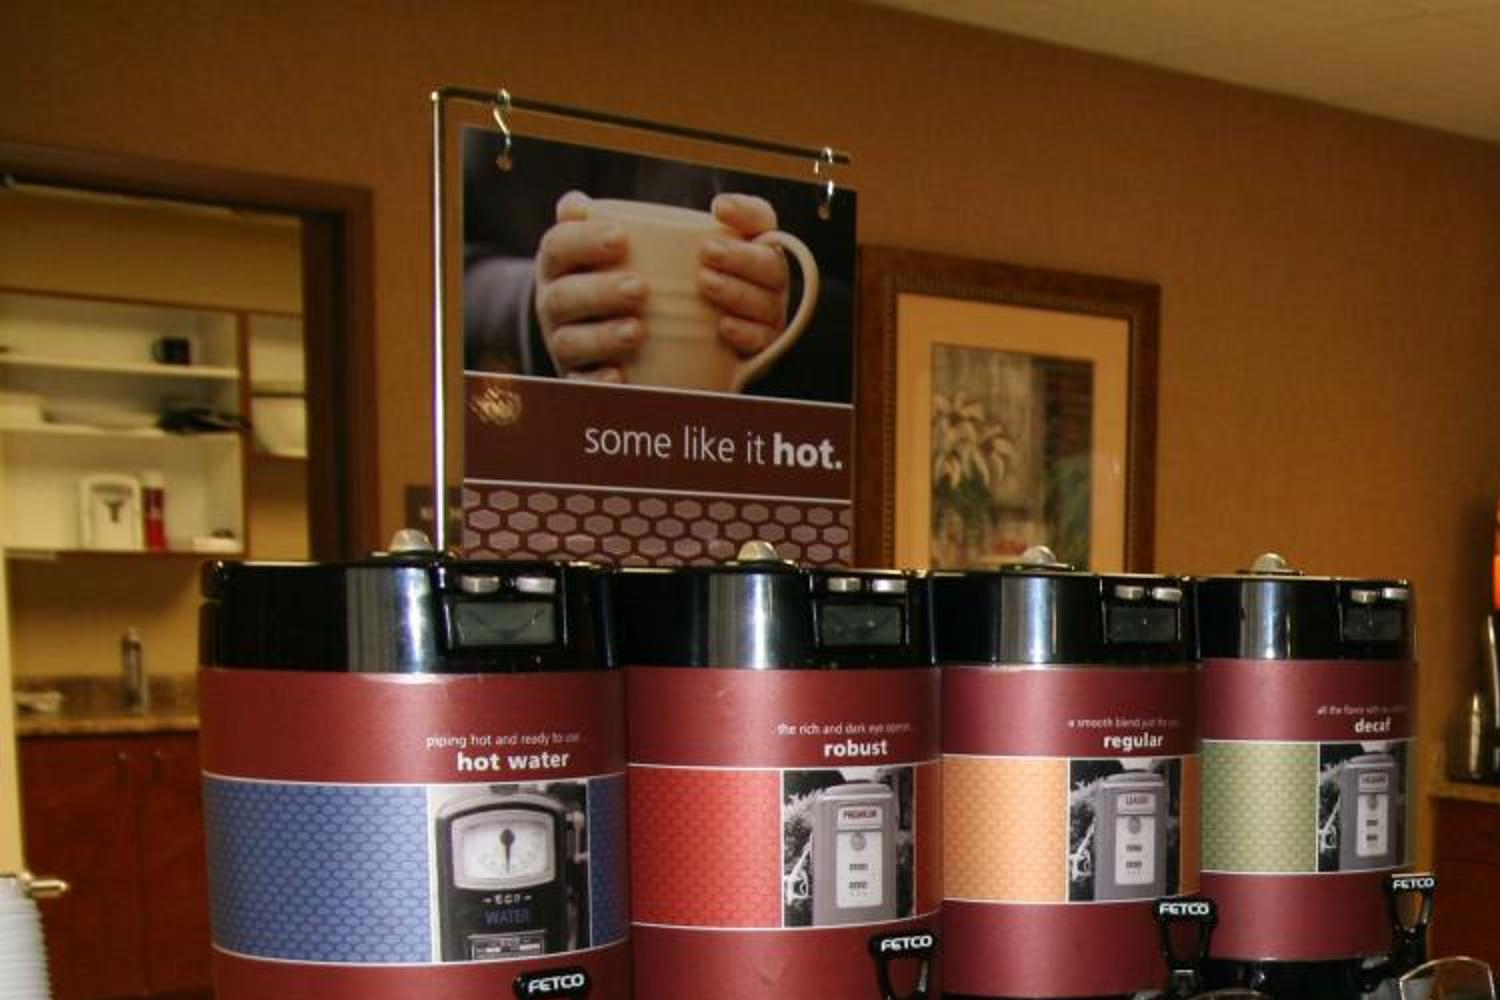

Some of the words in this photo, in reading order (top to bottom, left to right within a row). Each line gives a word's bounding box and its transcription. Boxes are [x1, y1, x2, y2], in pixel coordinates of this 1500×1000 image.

[584, 427, 672, 459] some
[683, 424, 736, 463] like
[747, 430, 766, 465] it
[773, 431, 844, 470] hot.
[778, 721, 797, 735] the
[799, 722, 820, 735] rich
[822, 722, 843, 735] and
[1077, 716, 1113, 728] smooth
[1355, 716, 1391, 733] decaf
[426, 733, 468, 748] piping
[470, 733, 493, 747] hot
[495, 733, 519, 746] and
[521, 732, 550, 747] ready
[823, 739, 888, 757] robust
[1103, 731, 1164, 752] regular
[456, 751, 501, 772] hot
[508, 751, 570, 769] water
[1393, 877, 1435, 891] FETCO
[1159, 902, 1210, 916] FETCO
[881, 935, 933, 952] FETCO
[528, 973, 585, 993] FETCO
